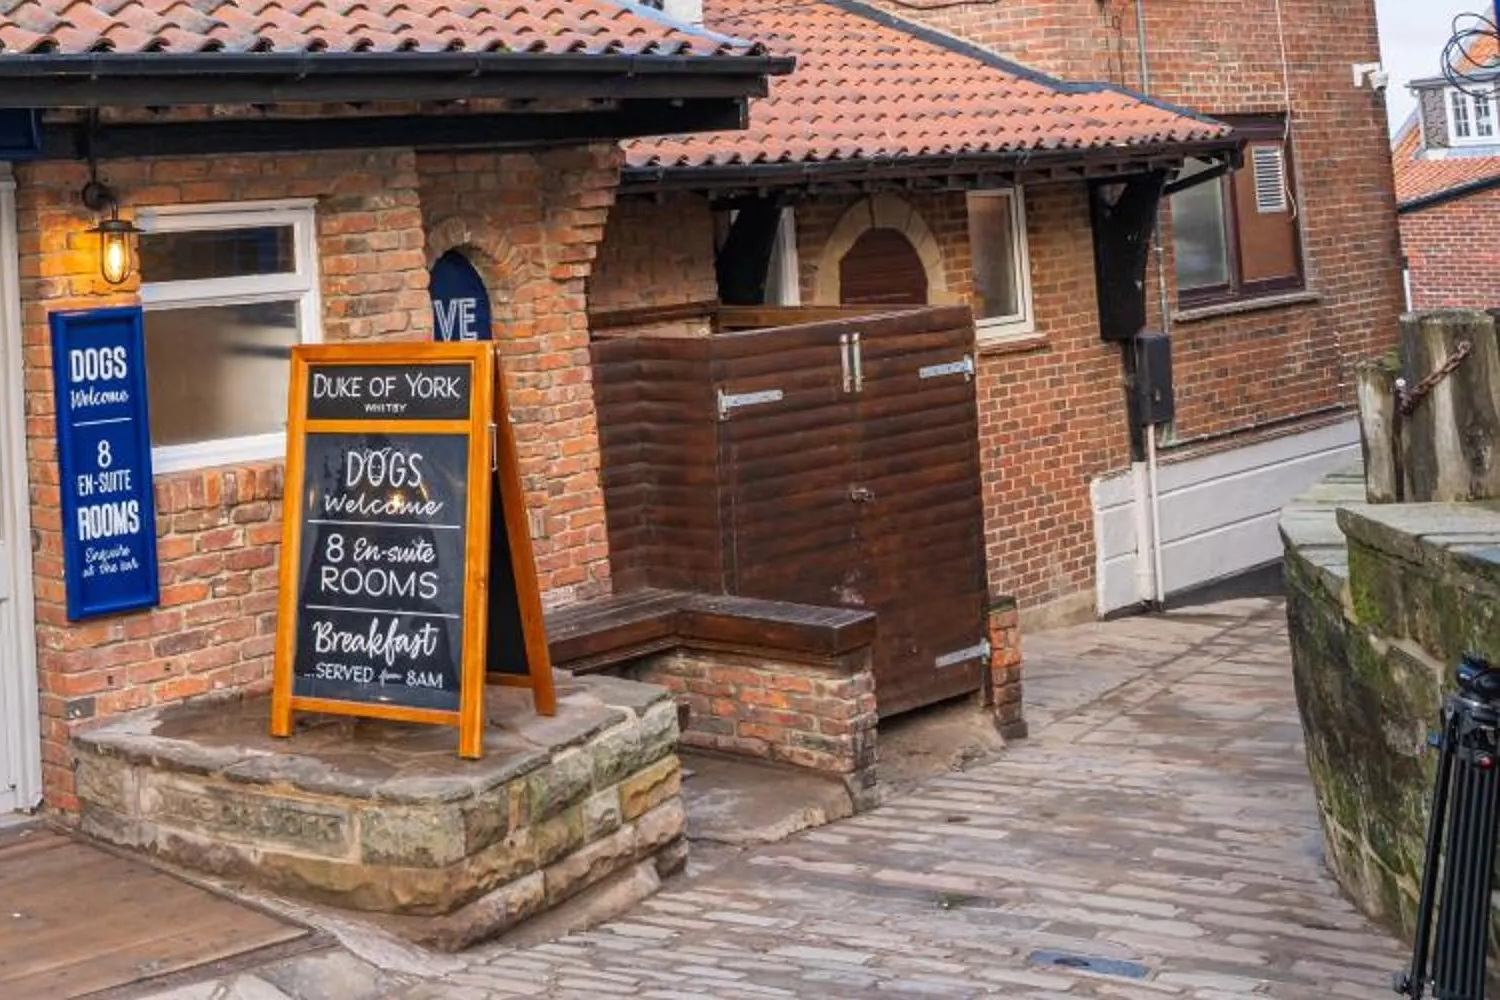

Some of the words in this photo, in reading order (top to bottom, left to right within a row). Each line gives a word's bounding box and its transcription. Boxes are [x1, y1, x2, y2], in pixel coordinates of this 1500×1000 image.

[71, 345, 127, 382] DOGS
[70, 385, 130, 412] Welcome
[312, 372, 363, 399] DUKE
[369, 376, 397, 398] OF
[404, 371, 461, 399] YORK
[364, 403, 408, 414] WHITBY
[97, 439, 112, 468] 8
[346, 447, 423, 488] DOGS
[77, 469, 132, 497] EN-SUITE
[77, 499, 140, 541] ROOMS
[326, 533, 345, 563] 8
[320, 566, 440, 599] ROOMS
[312, 617, 439, 666] Breakfast
[405, 670, 444, 689] 8AM
